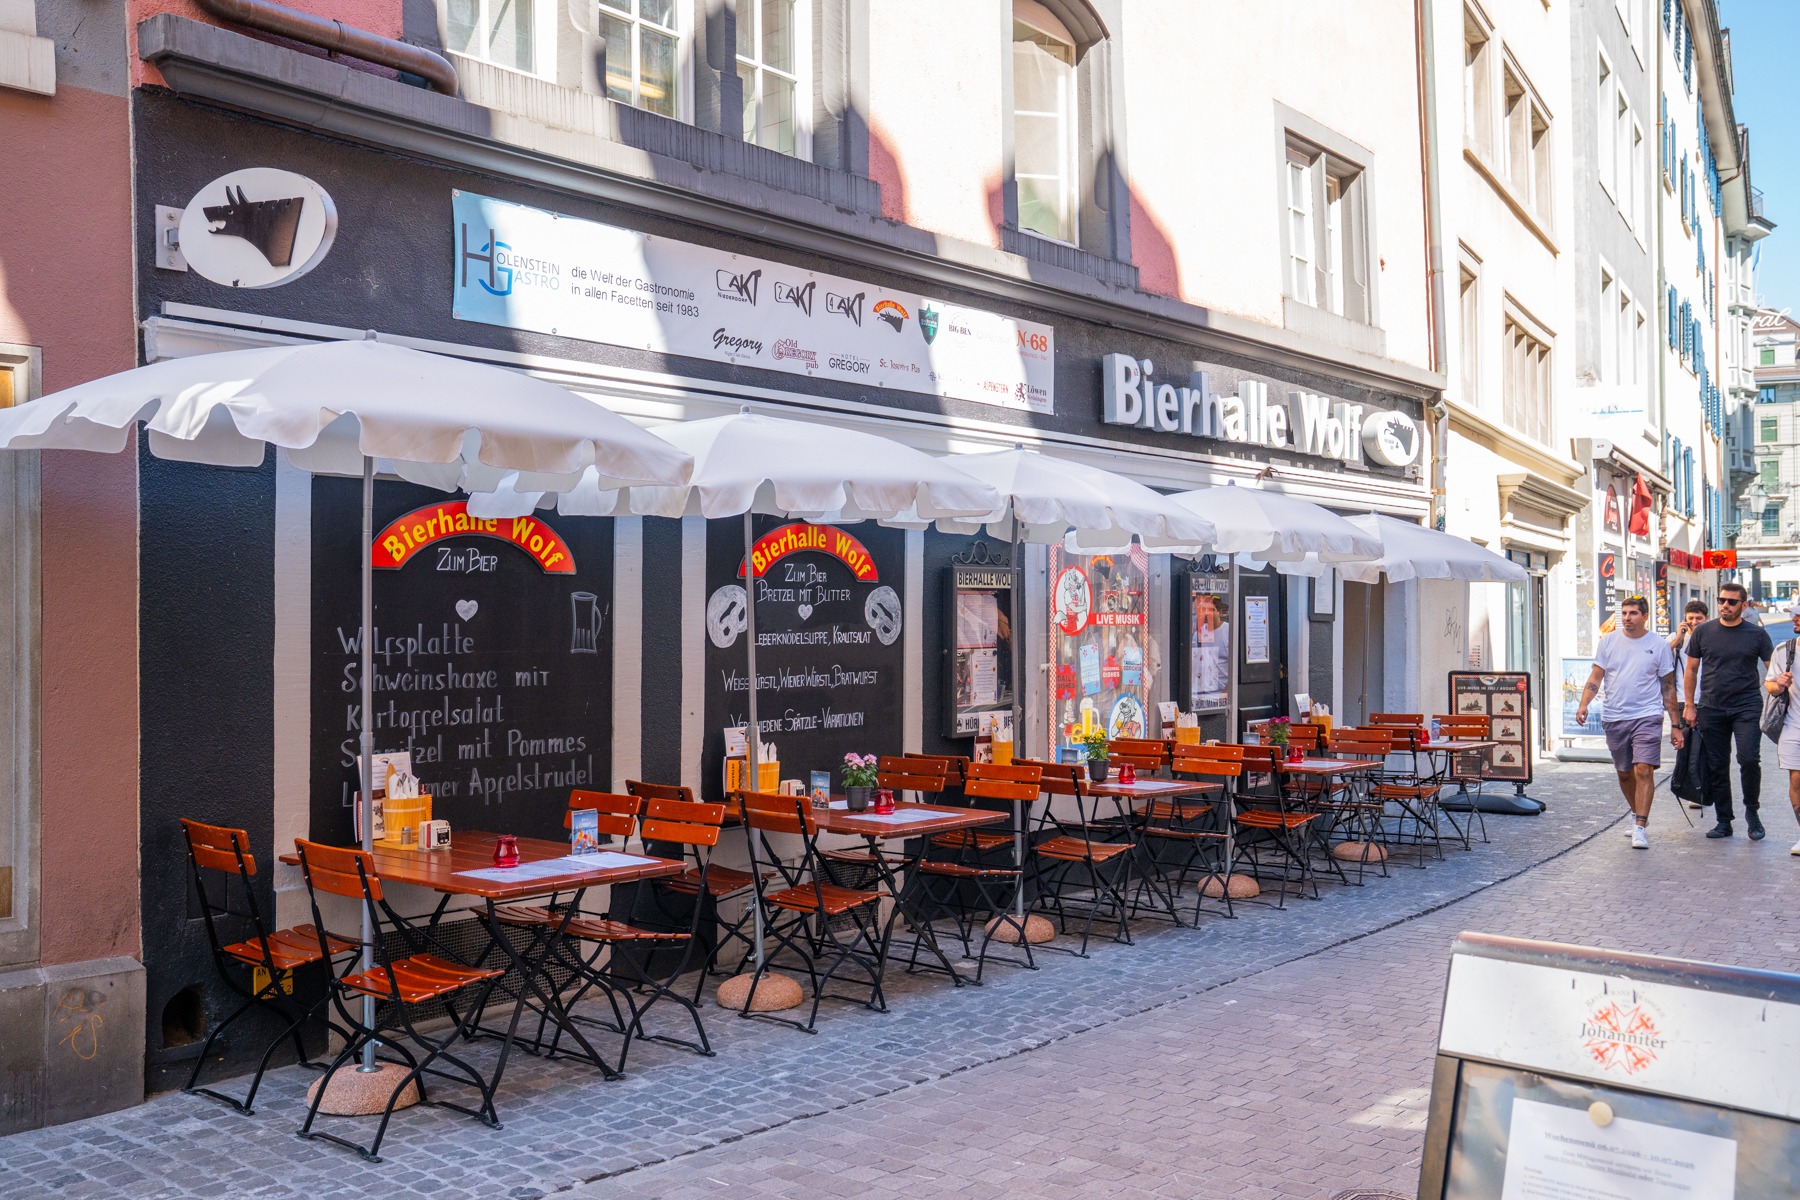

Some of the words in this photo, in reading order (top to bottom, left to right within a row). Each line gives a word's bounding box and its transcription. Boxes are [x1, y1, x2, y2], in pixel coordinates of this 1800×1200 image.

[571, 266, 587, 279] die
[590, 269, 613, 285] Welt
[616, 274, 632, 288] der
[634, 278, 695, 301] Gastronomie
[571, 283, 581, 295] in
[584, 285, 608, 301] allen
[611, 290, 653, 309] Facetten
[656, 300, 674, 314] seit
[676, 302, 700, 318] 1983
[713, 327, 763, 354] Gregory
[828, 358, 871, 374] GREGORY
[1103, 352, 1287, 449] Bierhalle
[1289, 391, 1362, 461] Wolf
[512, 517, 564, 568] Wolf
[751, 526, 827, 573] Bierhalle
[835, 532, 872, 577] Wolf
[958, 572, 994, 586] BIERHALLE
[994, 572, 1011, 586] WOL
[1096, 614, 1114, 625] LIVE
[1115, 614, 1140, 624] MUSIK
[336, 623, 474, 667] Wlfsplatte
[341, 662, 498, 693] Shweinshaxe
[1057, 674, 1076, 682] DAILY
[346, 695, 505, 740] Krtoffelsalat
[458, 728, 492, 761] mit
[508, 729, 587, 757] Pommes
[469, 754, 593, 806] Apfelstrudel
[1579, 1022, 1668, 1049] Johanniter
